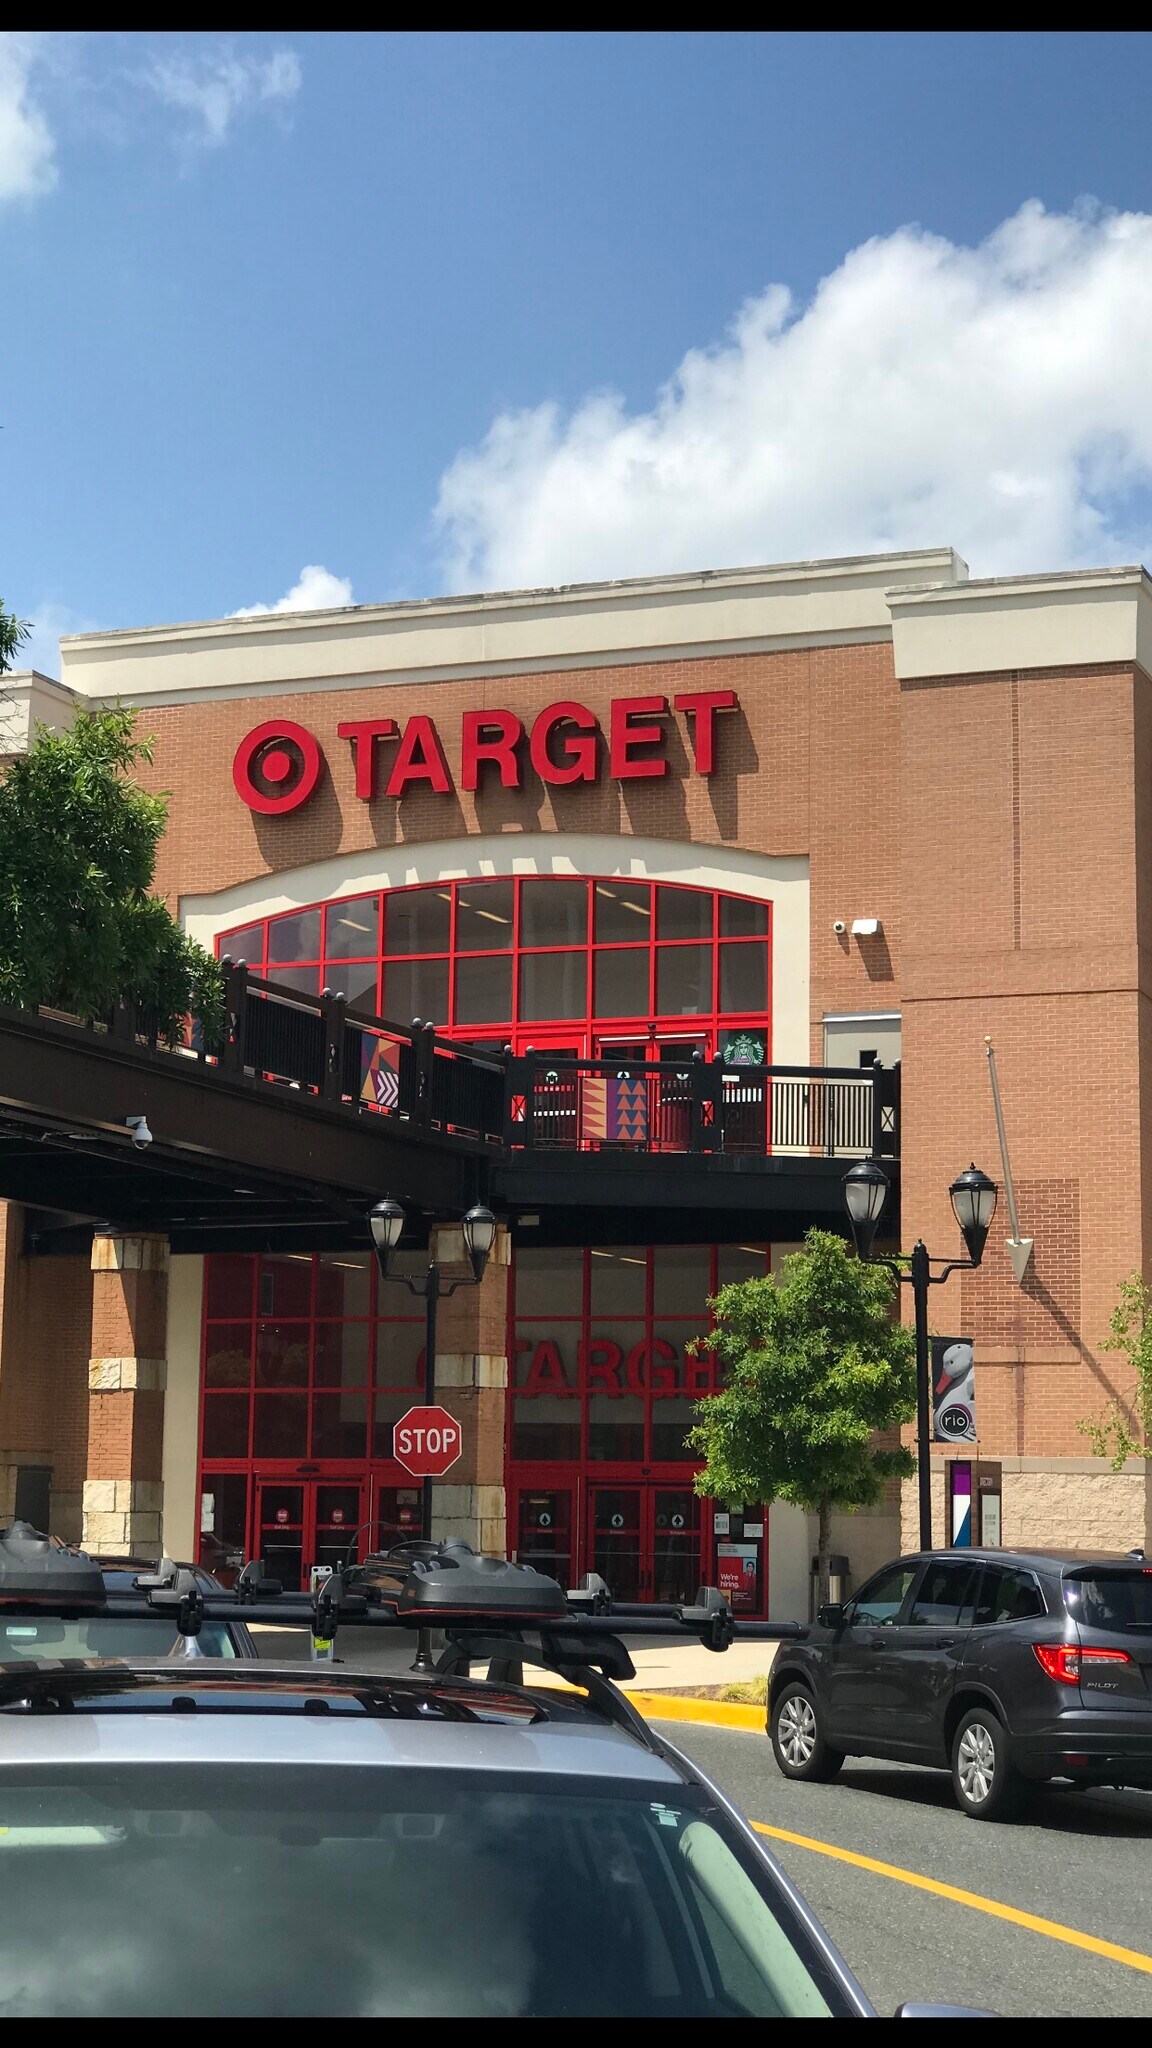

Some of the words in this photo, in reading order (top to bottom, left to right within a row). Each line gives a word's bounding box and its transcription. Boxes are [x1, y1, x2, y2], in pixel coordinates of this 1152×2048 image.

[338, 689, 738, 801] TARGET
[945, 1414, 966, 1427] rio
[399, 1428, 457, 1454] STOP
[720, 1573, 739, 1581] We're
[720, 1581, 740, 1589] hiring.
